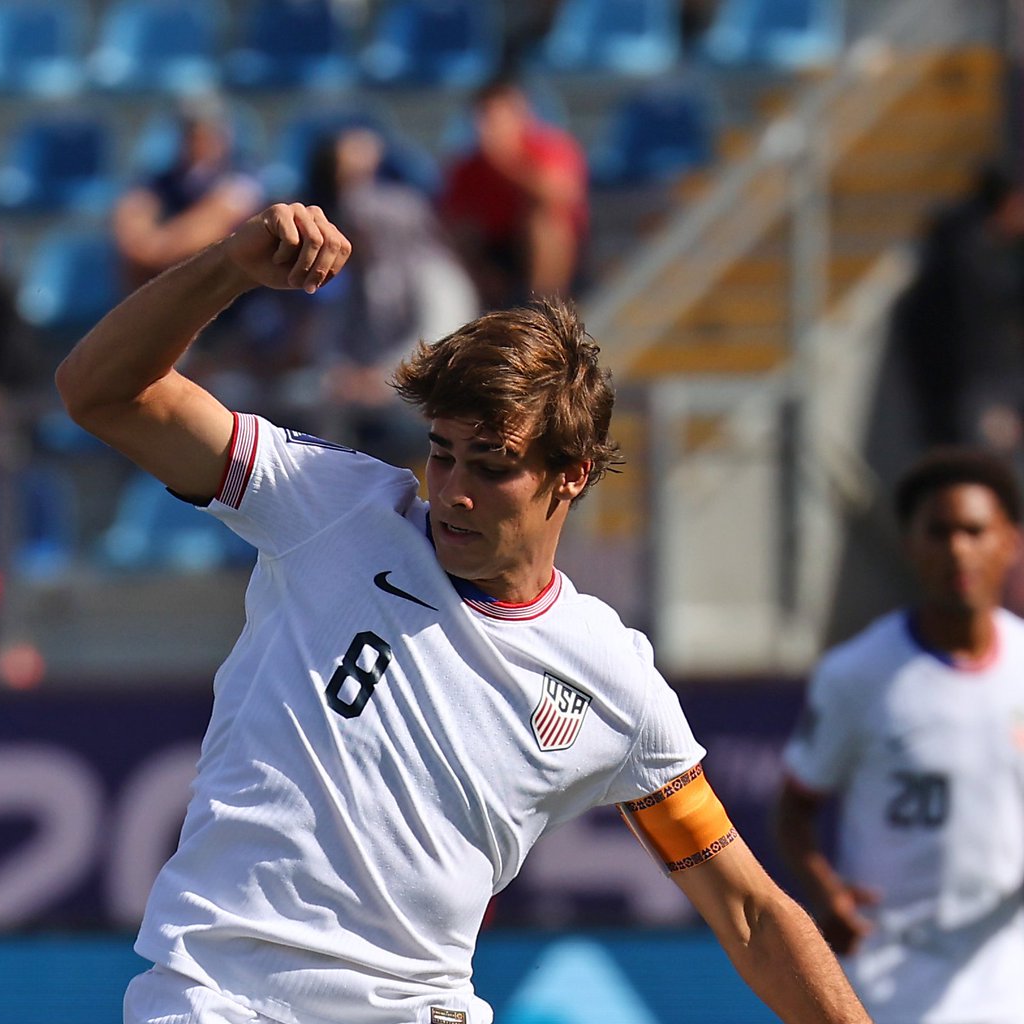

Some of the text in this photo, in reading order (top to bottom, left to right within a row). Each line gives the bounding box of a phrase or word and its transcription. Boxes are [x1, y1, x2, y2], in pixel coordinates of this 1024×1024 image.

[325, 630, 392, 719] 8
[547, 677, 587, 715] USA
[886, 769, 951, 829] 20
